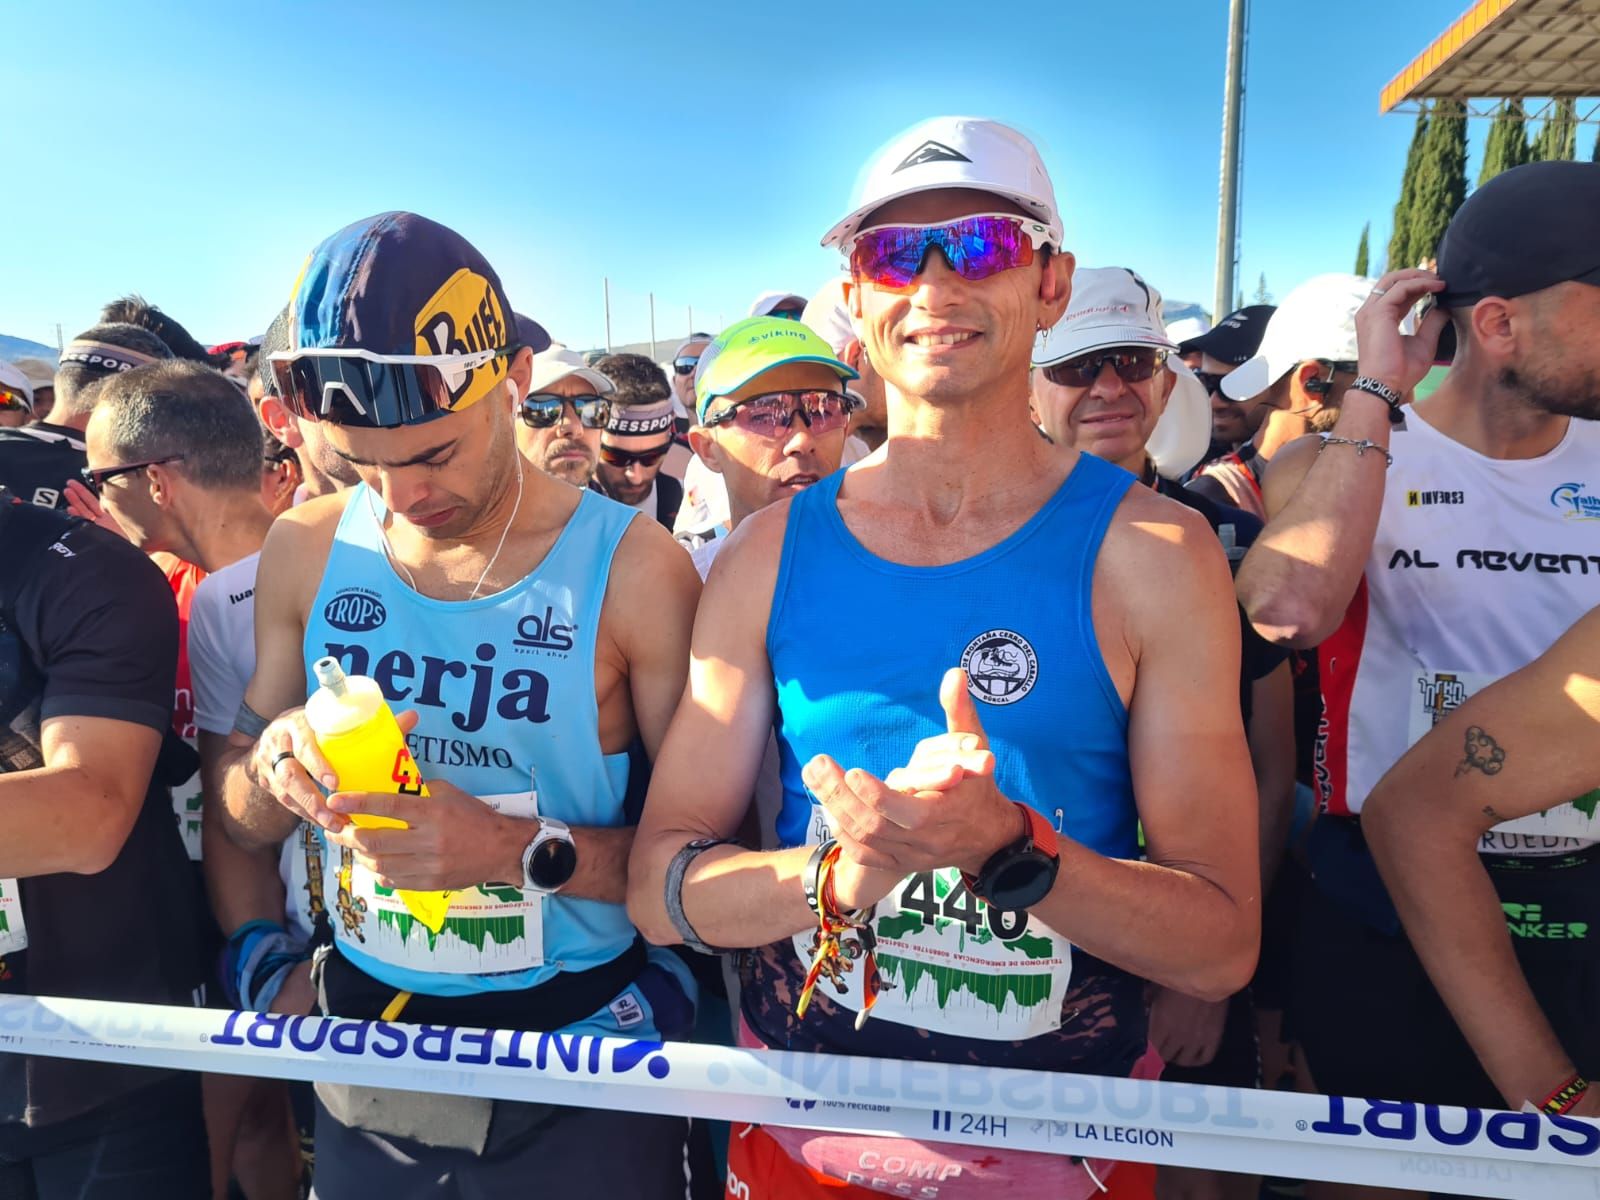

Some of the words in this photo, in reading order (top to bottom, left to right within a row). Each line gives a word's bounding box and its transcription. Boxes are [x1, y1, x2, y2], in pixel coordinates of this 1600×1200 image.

[1388, 549, 1439, 569] AL
[230, 587, 256, 605] lua
[327, 596, 384, 625] TROPS
[513, 606, 573, 651] als
[999, 630, 1024, 645] CERRO
[1021, 644, 1034, 659] DEL
[325, 642, 551, 733] nerja
[1481, 830, 1581, 850] RUEDA
[210, 1010, 612, 1075] INTERSPORT
[959, 1114, 1008, 1137] 24H
[1075, 1123, 1098, 1140] LA
[1311, 1096, 1600, 1156] SPORT
[858, 1151, 963, 1182] COMP
